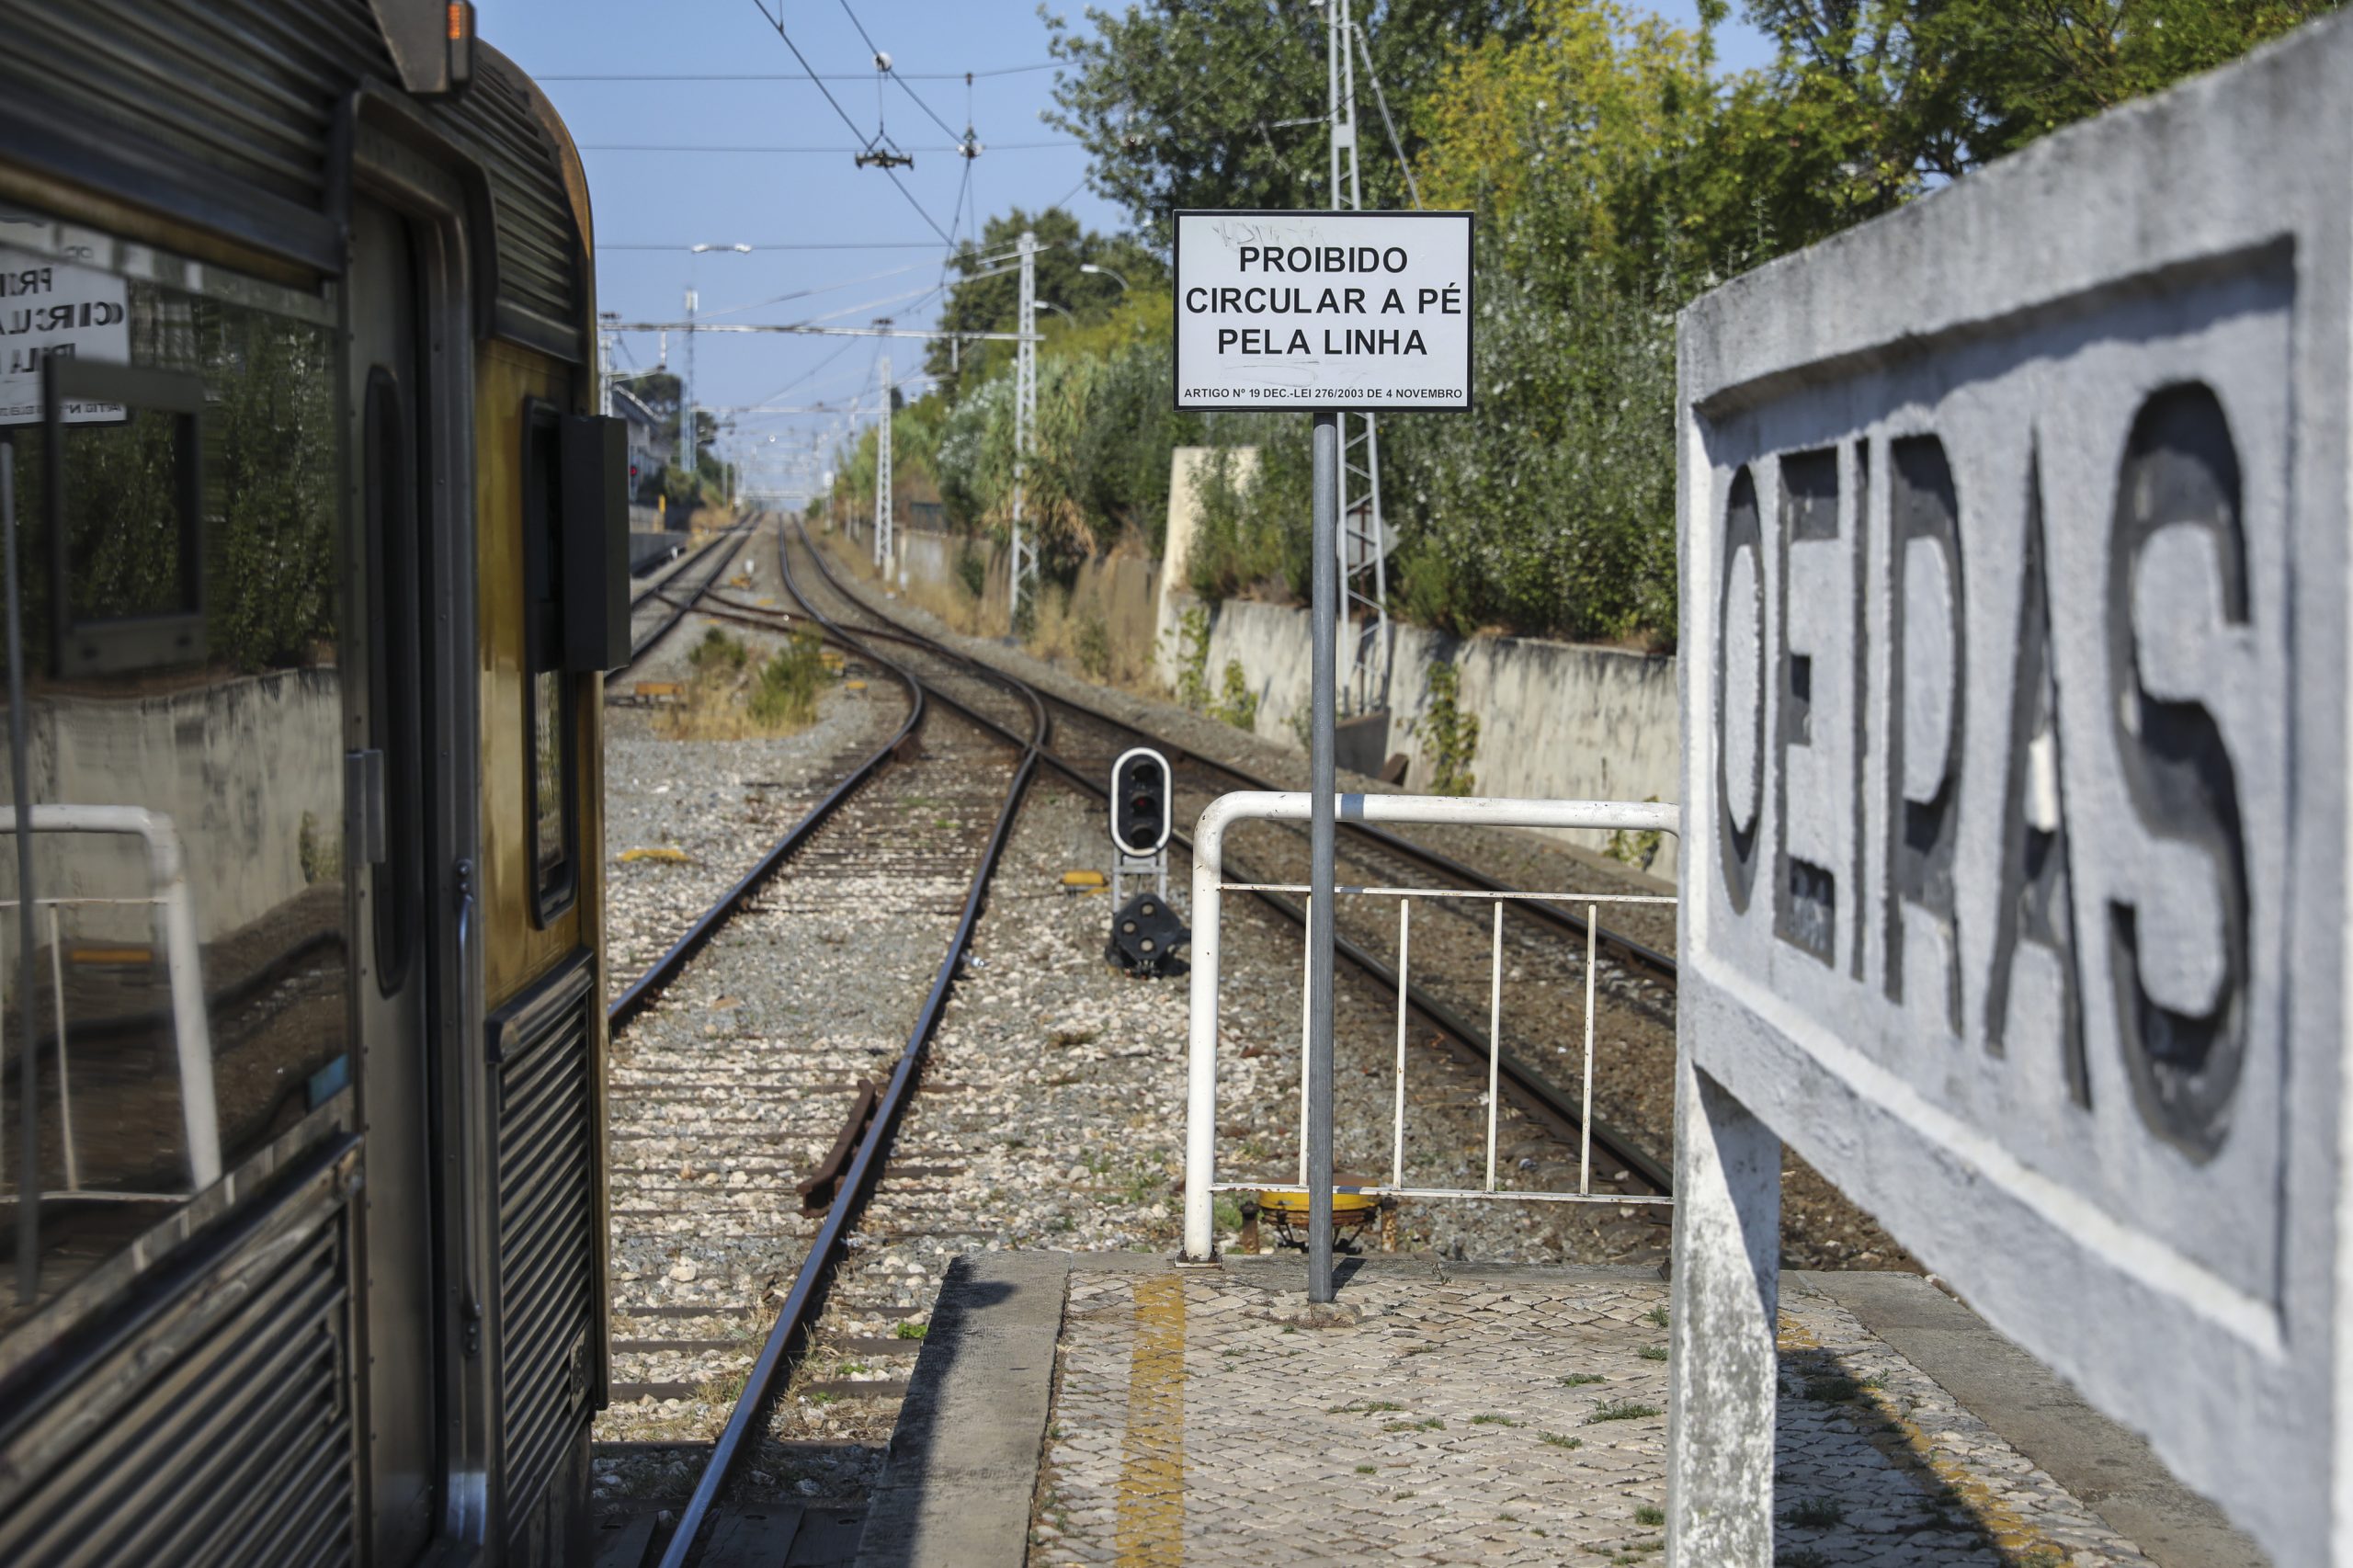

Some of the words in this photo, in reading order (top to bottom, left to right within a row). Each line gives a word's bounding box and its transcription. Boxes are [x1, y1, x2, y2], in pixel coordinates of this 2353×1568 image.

[1239, 246, 1408, 273] PROIBIDO
[1186, 287, 1367, 314] CIRCULAR
[1381, 288, 1405, 314] A
[1418, 281, 1461, 314] PÉ
[1218, 328, 1312, 355] PELA
[1324, 329, 1427, 356] LINHA
[1184, 388, 1230, 399] ARTIGO
[1249, 388, 1261, 398] 19
[1263, 388, 1313, 398] DEC.-LEI
[1314, 388, 1364, 399] 276/2003
[1367, 388, 1382, 398] DE
[1385, 388, 1393, 399] 4
[1395, 388, 1463, 399] NOVEMBRO
[1716, 381, 2250, 1165] OEIRAS
